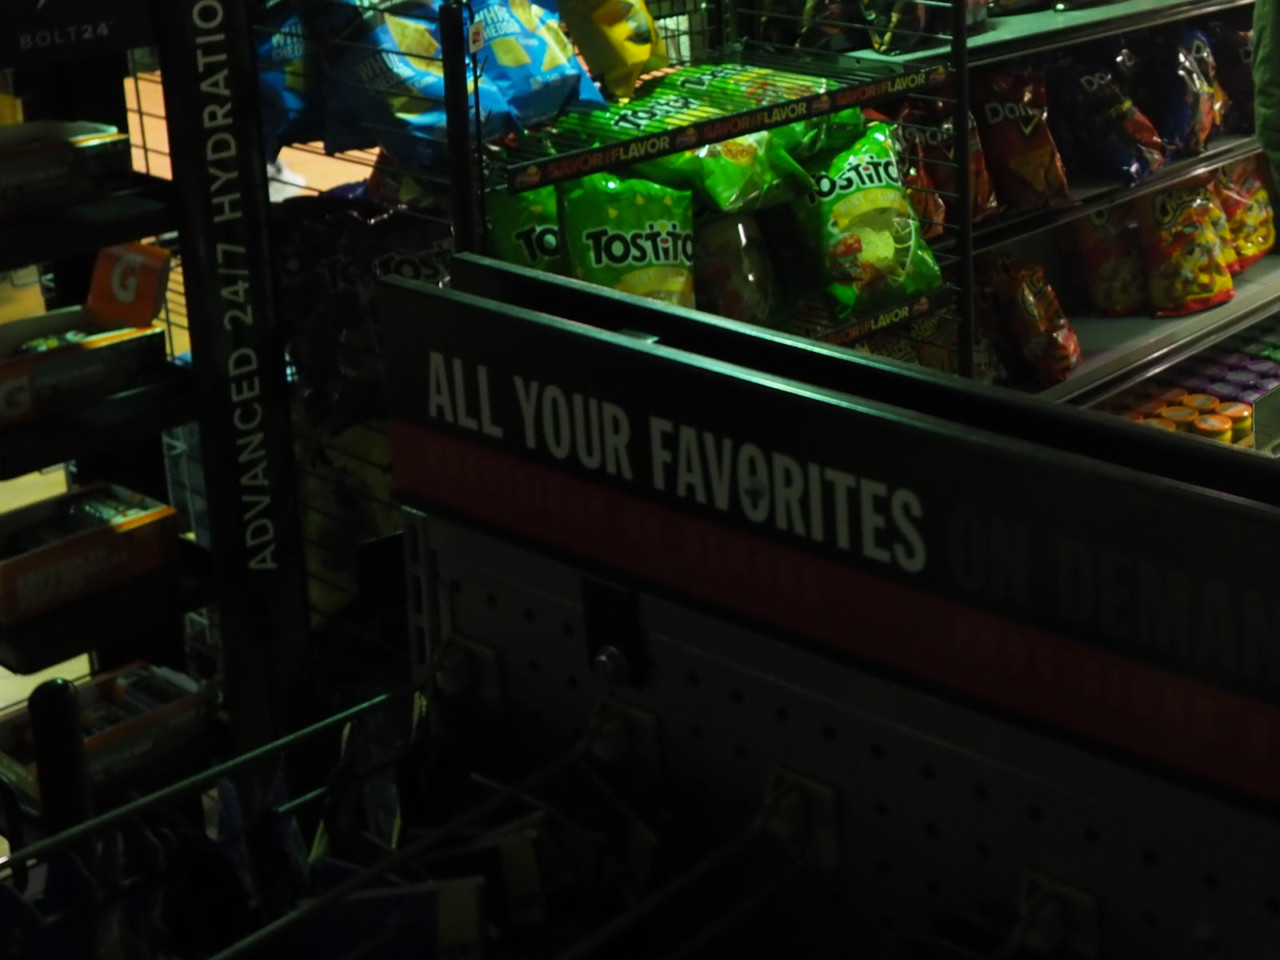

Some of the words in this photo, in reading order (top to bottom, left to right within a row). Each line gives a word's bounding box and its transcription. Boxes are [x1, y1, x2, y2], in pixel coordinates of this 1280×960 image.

[20, 20, 109, 50] BOLT24
[880, 72, 926, 95] FLAVOR
[757, 102, 808, 125] FLAVOR
[612, 135, 671, 163] FLAVOR
[585, 220, 695, 267] Tostito
[111, 253, 143, 303] G
[211, 245, 253, 329] 24/7
[228, 344, 278, 573] ADVANCED
[427, 351, 504, 440] ALL
[512, 375, 635, 482] YOUR
[648, 416, 928, 575] FAVORITES
